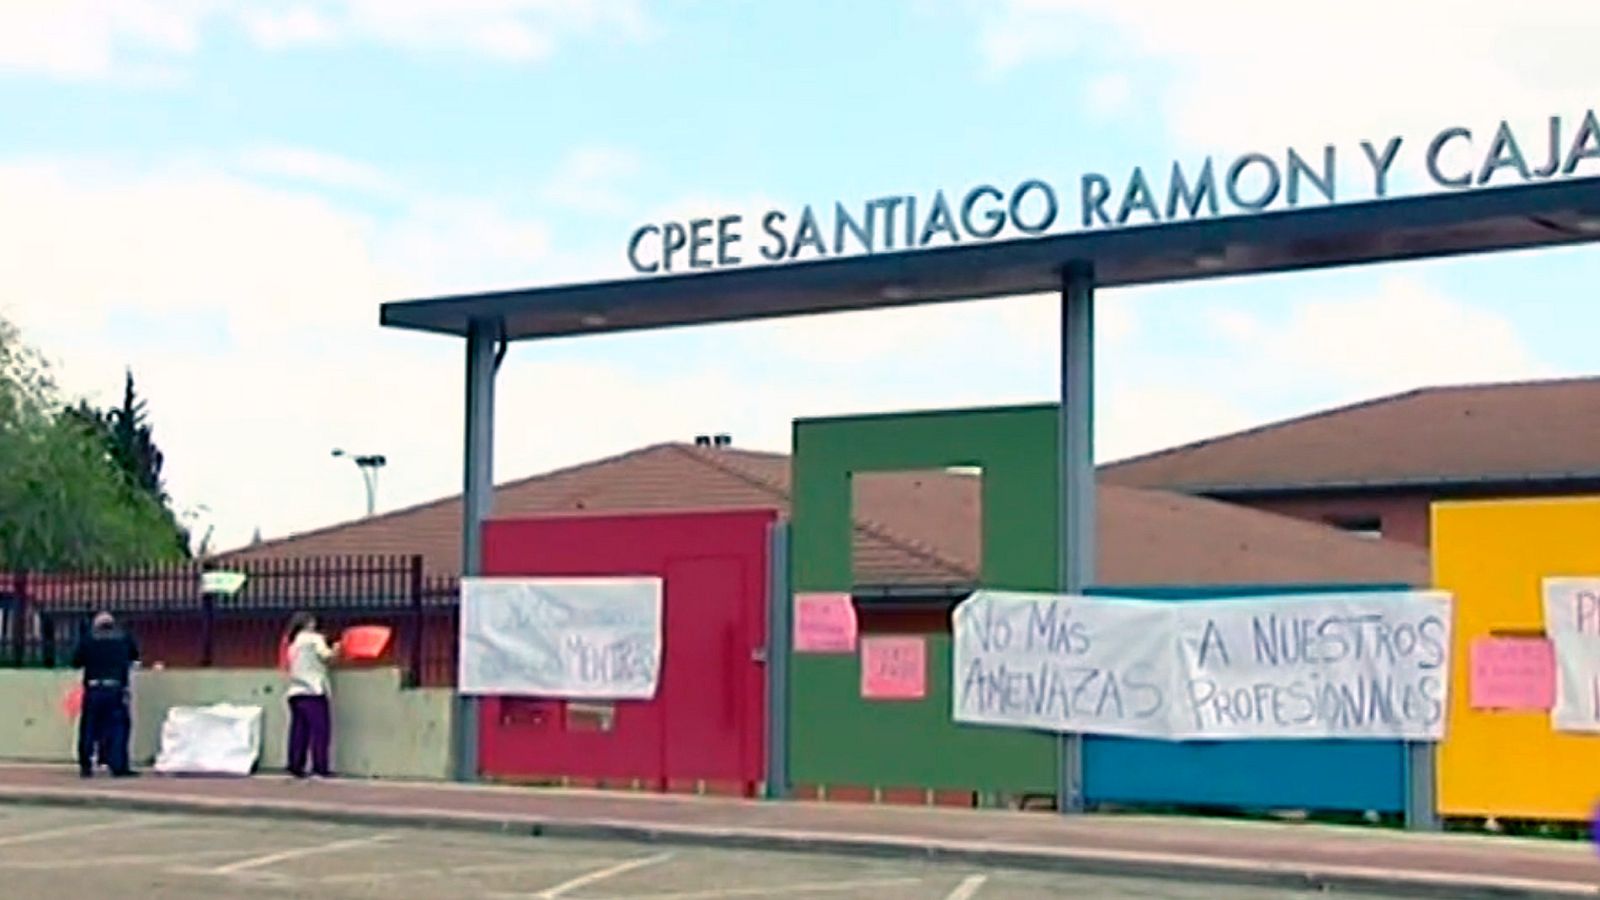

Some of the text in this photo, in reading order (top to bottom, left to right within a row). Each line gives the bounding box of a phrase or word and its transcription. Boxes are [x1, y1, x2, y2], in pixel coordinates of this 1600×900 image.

[627, 214, 742, 274] CPEE
[760, 179, 1058, 261] SANTIAGO
[1080, 145, 1335, 228] RAMON
[1359, 136, 1403, 197] Y
[1198, 618, 1230, 669] A
[1252, 613, 1445, 670] NUESTROS
[962, 656, 1164, 719] AMENAZAS
